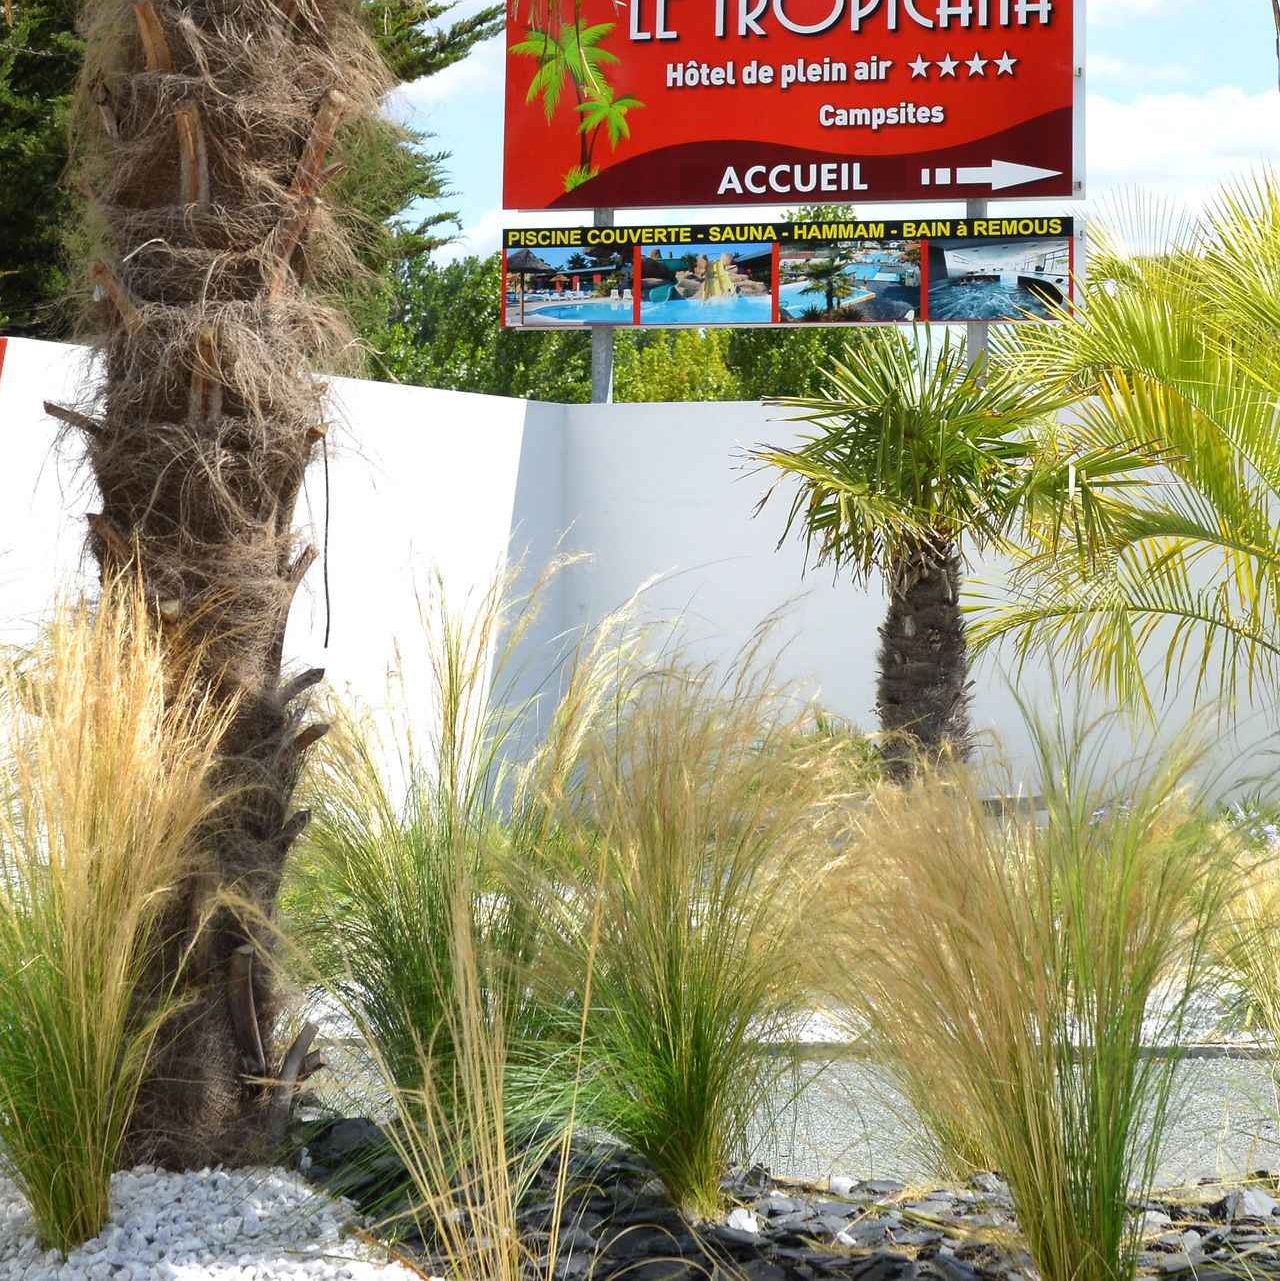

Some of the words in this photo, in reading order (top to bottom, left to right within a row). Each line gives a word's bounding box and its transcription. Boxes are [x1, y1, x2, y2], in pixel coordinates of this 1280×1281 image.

[666, 60, 736, 87] Hôtel
[742, 60, 774, 84] de
[781, 57, 847, 88] plein
[854, 55, 893, 80] air
[819, 102, 945, 129] Campsites
[717, 163, 869, 194] ACCUEIL
[508, 230, 582, 246] PISCINE
[587, 227, 692, 244] COUVERTE
[708, 225, 777, 243] SAUNA
[794, 223, 885, 240] HAMMAM
[903, 222, 951, 238] BAIN
[956, 221, 968, 237] à
[973, 219, 1063, 236] REMOUS
